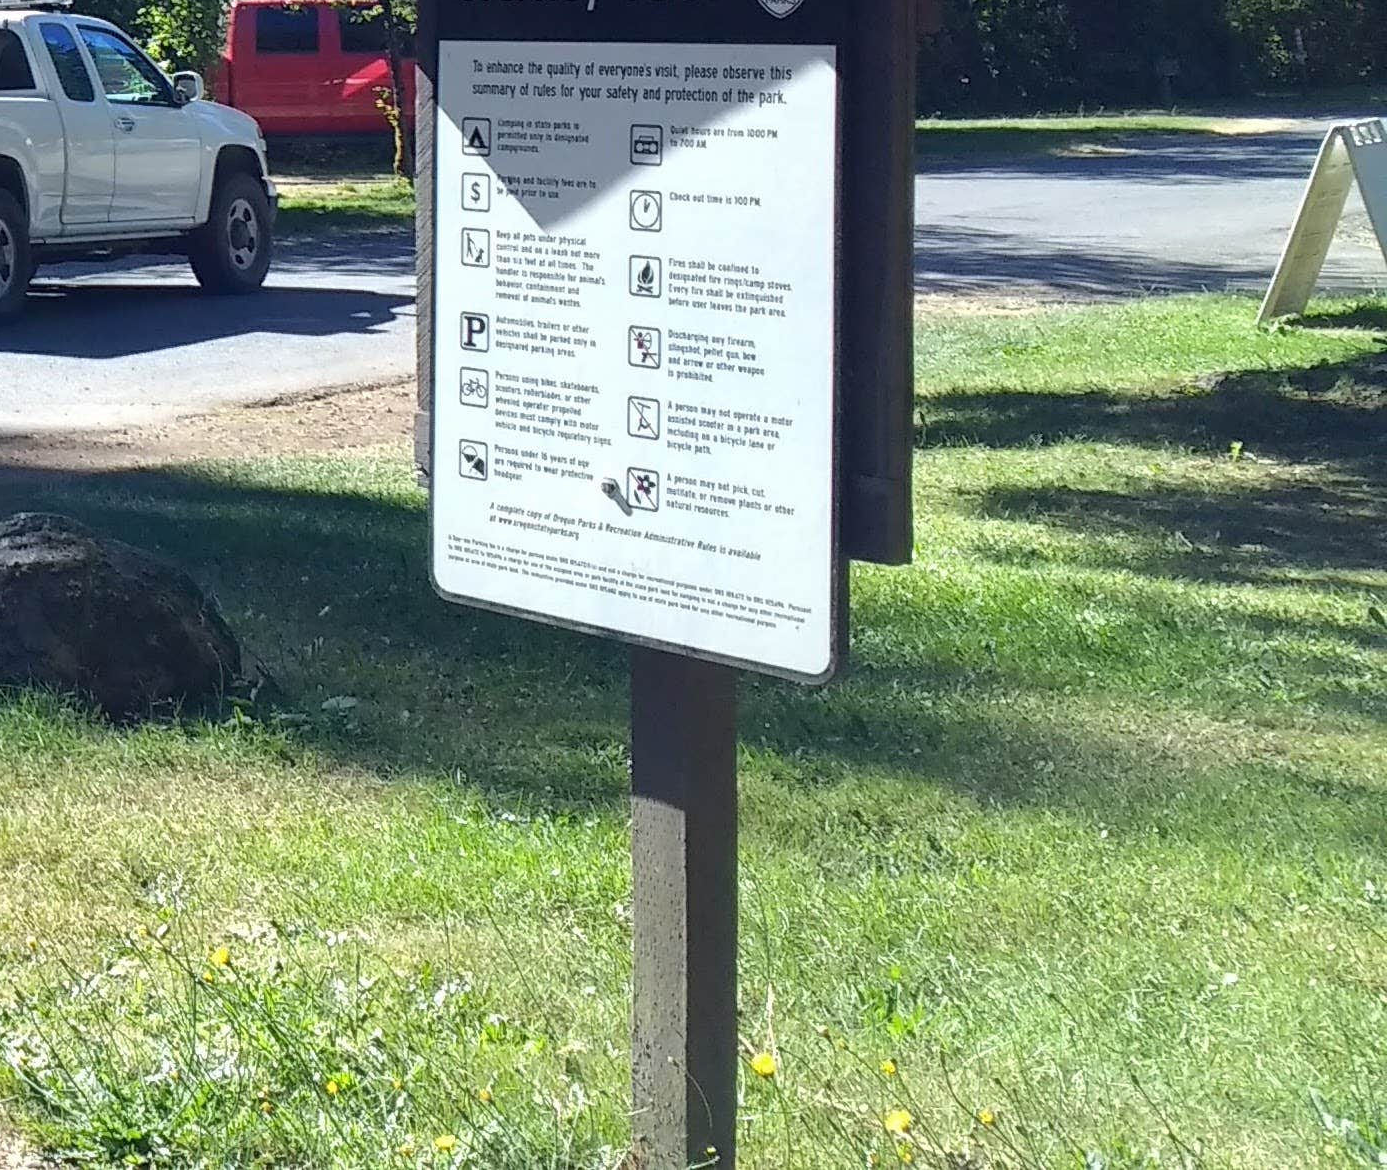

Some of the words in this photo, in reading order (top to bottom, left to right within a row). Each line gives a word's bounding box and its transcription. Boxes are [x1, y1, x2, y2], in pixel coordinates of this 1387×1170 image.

[473, 59, 482, 72] To
[486, 60, 524, 73] enhance
[528, 61, 543, 73] the
[546, 61, 580, 78] quality
[584, 62, 594, 75] of
[598, 63, 652, 79] everyone's
[684, 64, 718, 81] please
[722, 65, 765, 79] observe
[770, 66, 792, 80] this
[471, 84, 516, 99] summary
[519, 83, 529, 95] of
[533, 83, 556, 96] rules
[560, 84, 574, 97] for
[578, 87, 602, 101] your
[606, 85, 639, 103] safety
[642, 86, 661, 100] and
[664, 87, 718, 104] protection
[721, 89, 734, 102] of
[737, 89, 754, 103] the
[758, 90, 786, 107] park.
